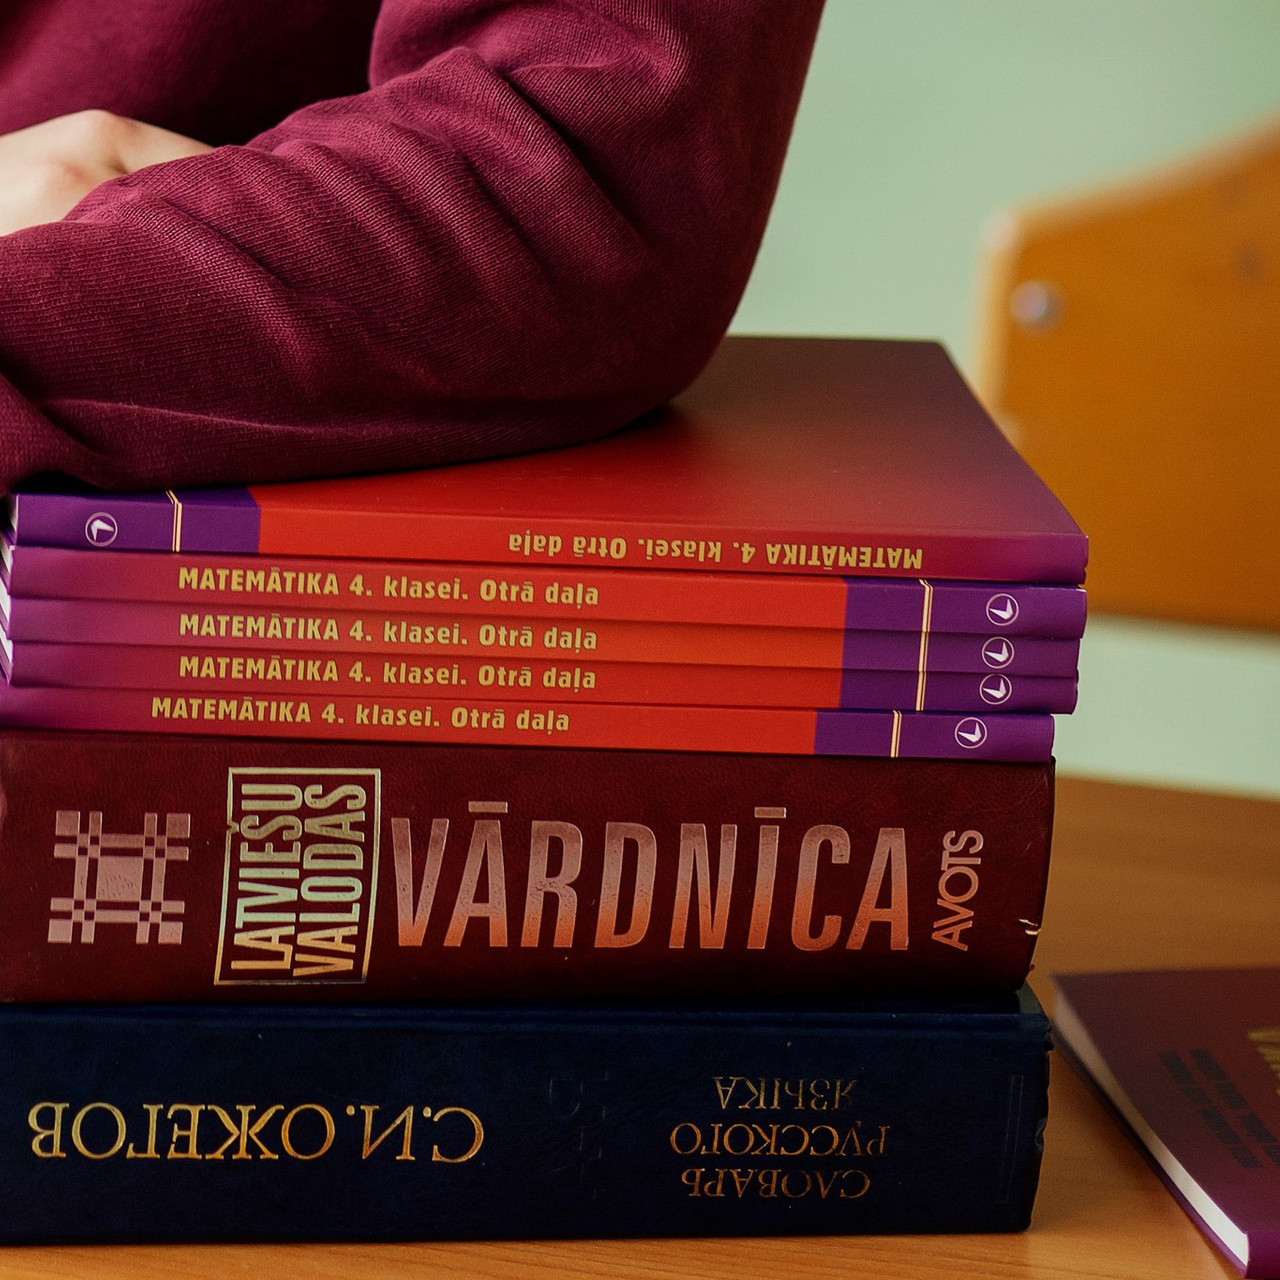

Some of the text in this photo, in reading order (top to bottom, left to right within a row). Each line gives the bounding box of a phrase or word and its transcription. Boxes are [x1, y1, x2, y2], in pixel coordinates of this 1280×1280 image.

[508, 530, 923, 571] MATEMĀTIKA 4. klasei. Otrā daļa
[178, 566, 599, 610] MATEMĀTIKA 4. klasei. Otrā daļa
[179, 612, 598, 654] MATEMĀTIKA 4. klasei. Otrā daļa
[179, 655, 597, 694] MATEMĀTIKA 4. klasei. Otrā daļa
[151, 696, 570, 735] MATEMĀTIKA 4. klasei. Otrā daļa
[293, 783, 367, 977] VALODAS
[391, 801, 910, 951] VĀRDNĪCA
[931, 829, 984, 951] AVOTS
[711, 1076, 859, 1110] ЯЗЫКА
[670, 1120, 891, 1157] РУССКОГО
[681, 1168, 871, 1198] СЛОВАРЬ
